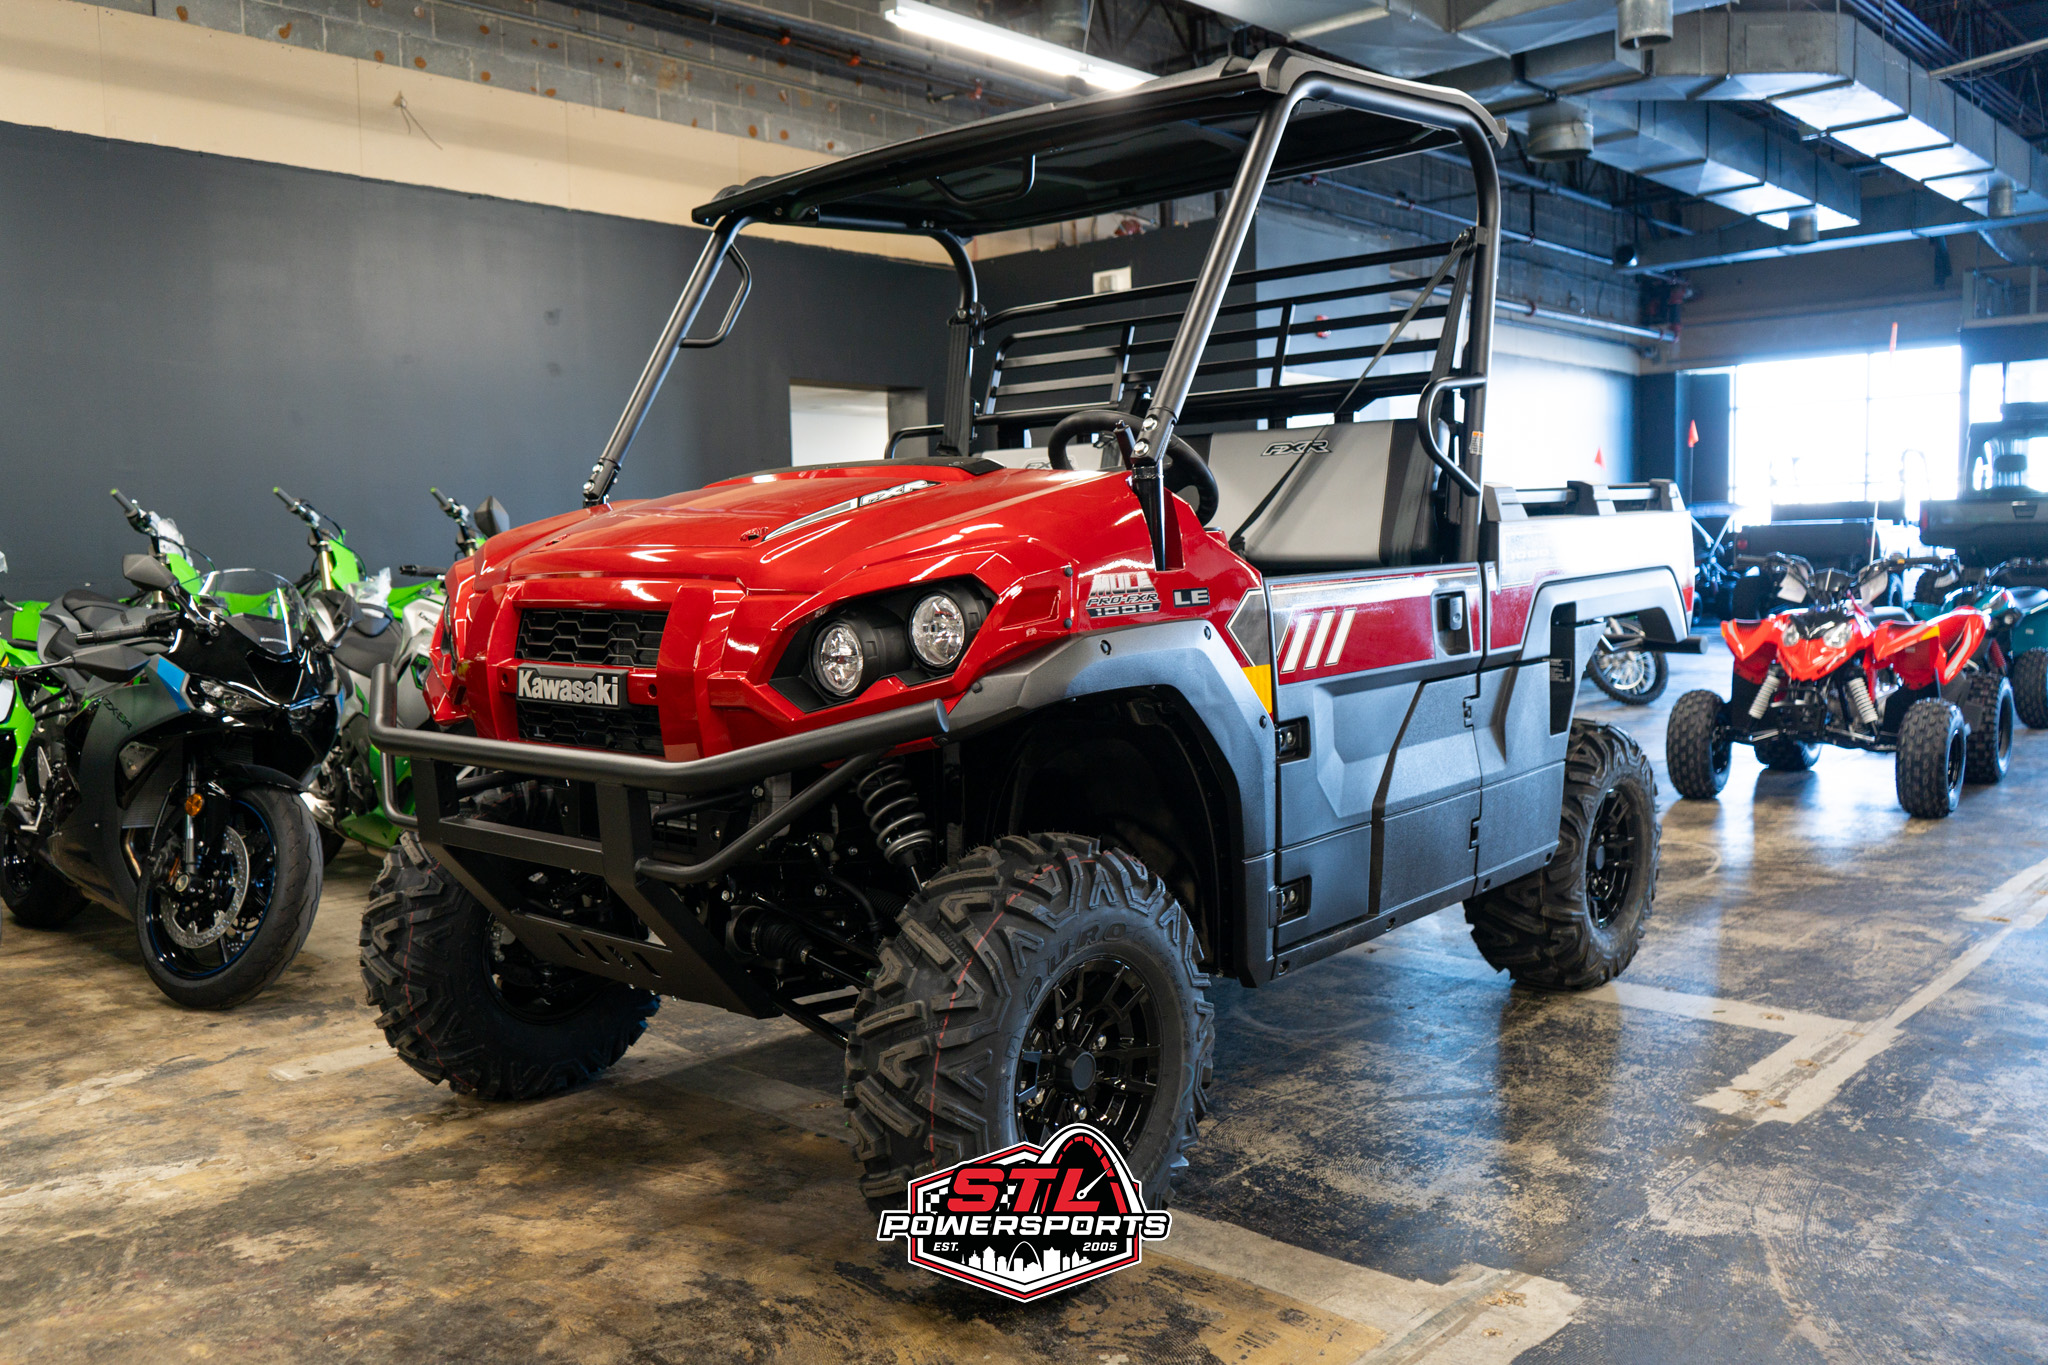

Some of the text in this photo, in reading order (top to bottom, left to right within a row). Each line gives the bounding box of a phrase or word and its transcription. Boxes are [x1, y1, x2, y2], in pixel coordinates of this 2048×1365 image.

[1261, 440, 1331, 456] FXR
[860, 480, 937, 506] FXR
[1090, 571, 1156, 596] MULE
[1086, 593, 1159, 607] PRO-FXR
[1174, 590, 1209, 606] LE
[1096, 604, 1154, 616] 1000
[519, 671, 618, 706] Kawasaki
[1026, 922, 1126, 1013] DURO
